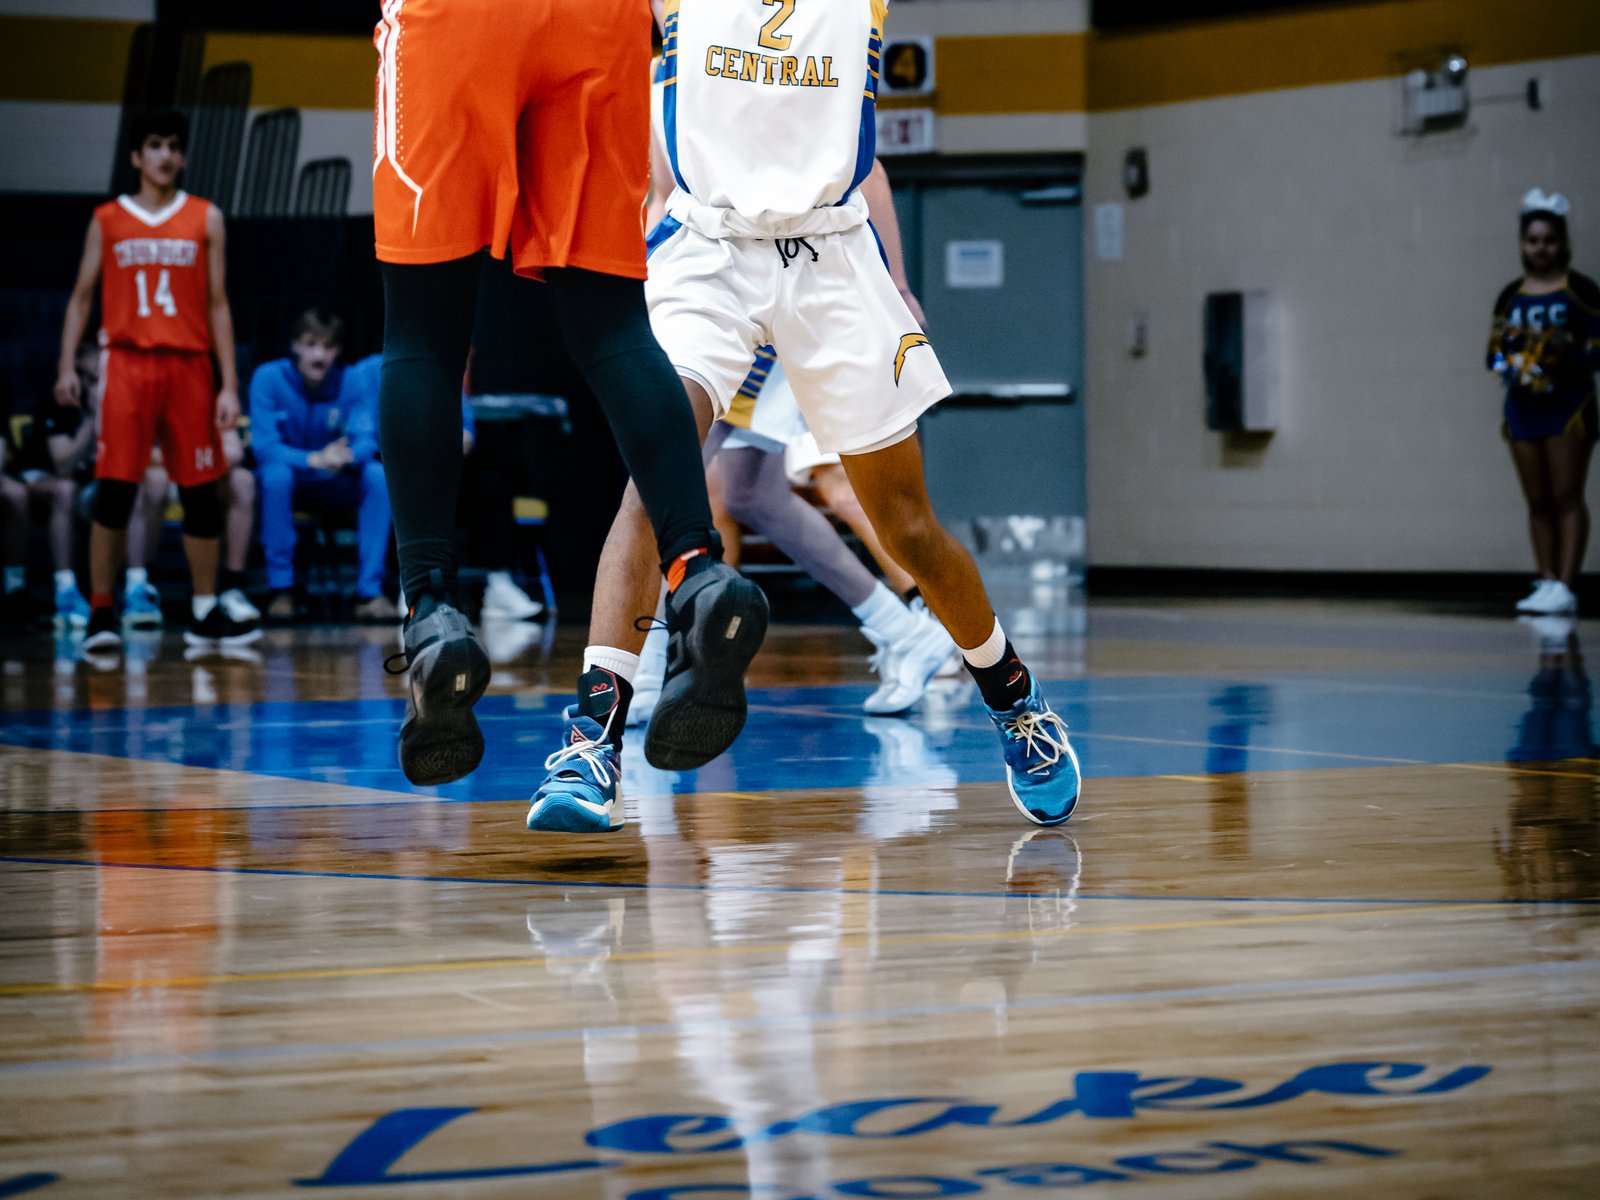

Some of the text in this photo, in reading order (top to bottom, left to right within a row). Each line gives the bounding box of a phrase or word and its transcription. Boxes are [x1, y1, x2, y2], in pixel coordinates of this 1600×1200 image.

[704, 44, 840, 88] CENTRAL
[892, 46, 918, 86] 4
[134, 270, 178, 318] 14
[292, 1061, 1493, 1188] Leake
